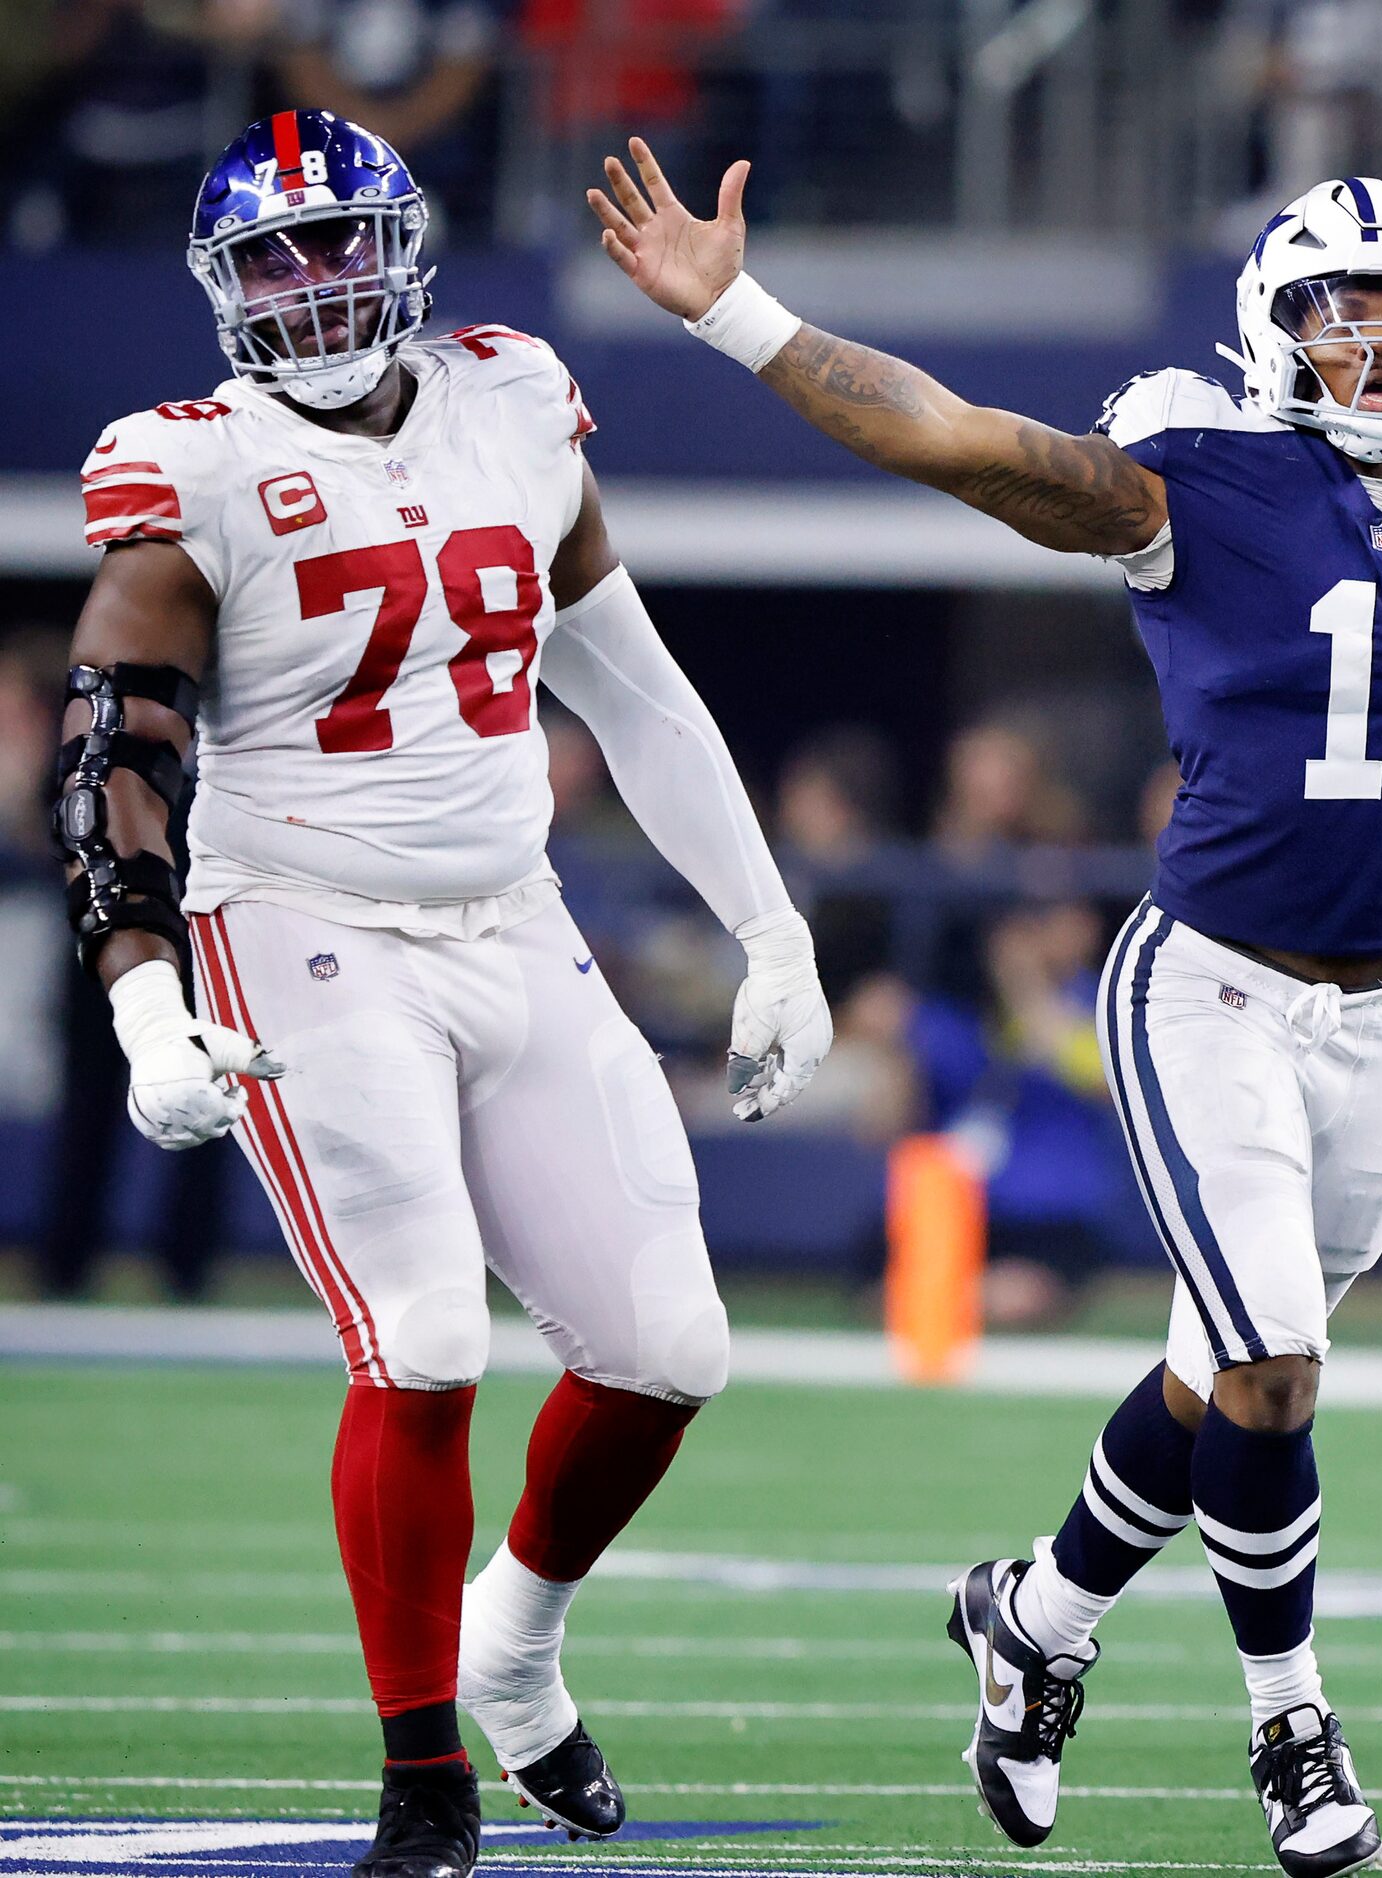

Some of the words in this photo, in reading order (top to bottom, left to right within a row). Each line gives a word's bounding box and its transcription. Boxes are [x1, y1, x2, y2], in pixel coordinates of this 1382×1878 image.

[300, 150, 328, 185] 8
[264, 475, 318, 520] C
[293, 524, 544, 754] 78
[1222, 991, 1243, 1006] NFL
